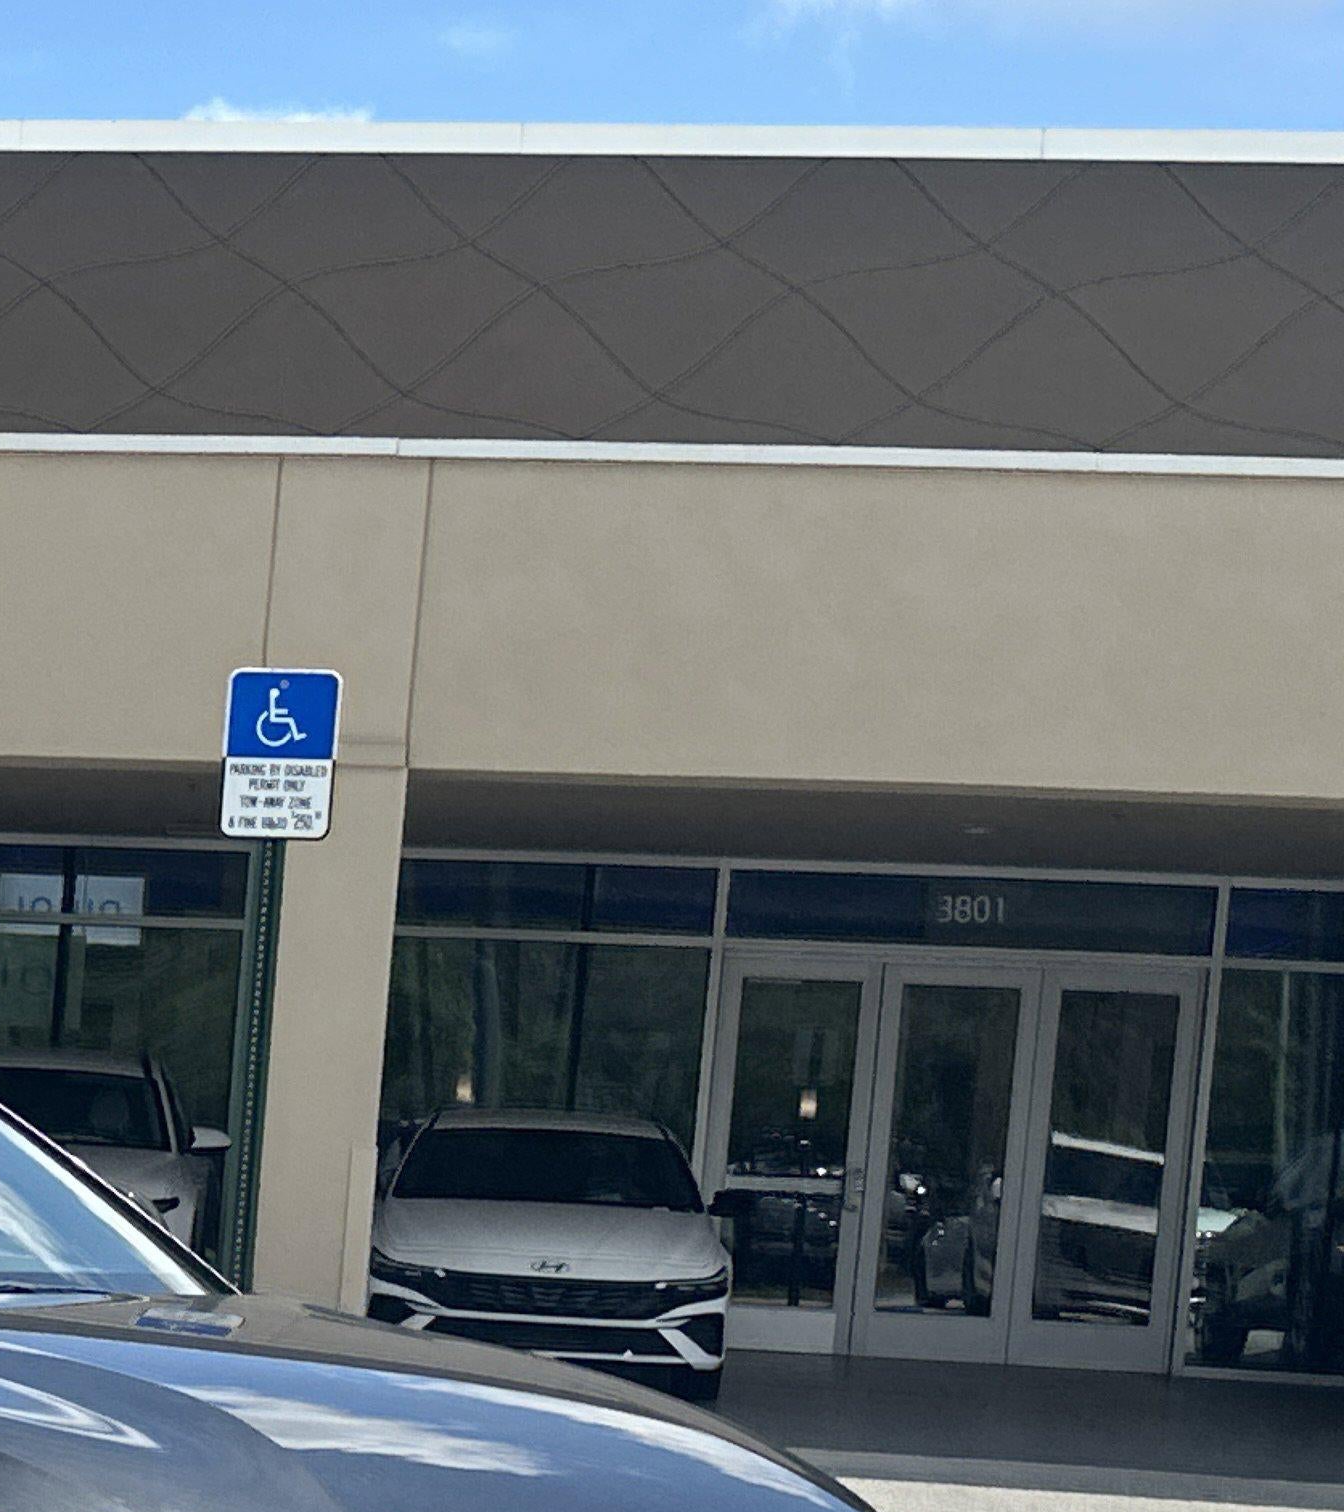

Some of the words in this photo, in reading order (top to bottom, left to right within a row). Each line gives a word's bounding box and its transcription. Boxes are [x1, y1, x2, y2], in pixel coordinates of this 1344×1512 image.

[229, 763, 267, 776] PARKING
[284, 764, 327, 777] DISABLED
[936, 895, 1005, 923] 3801
